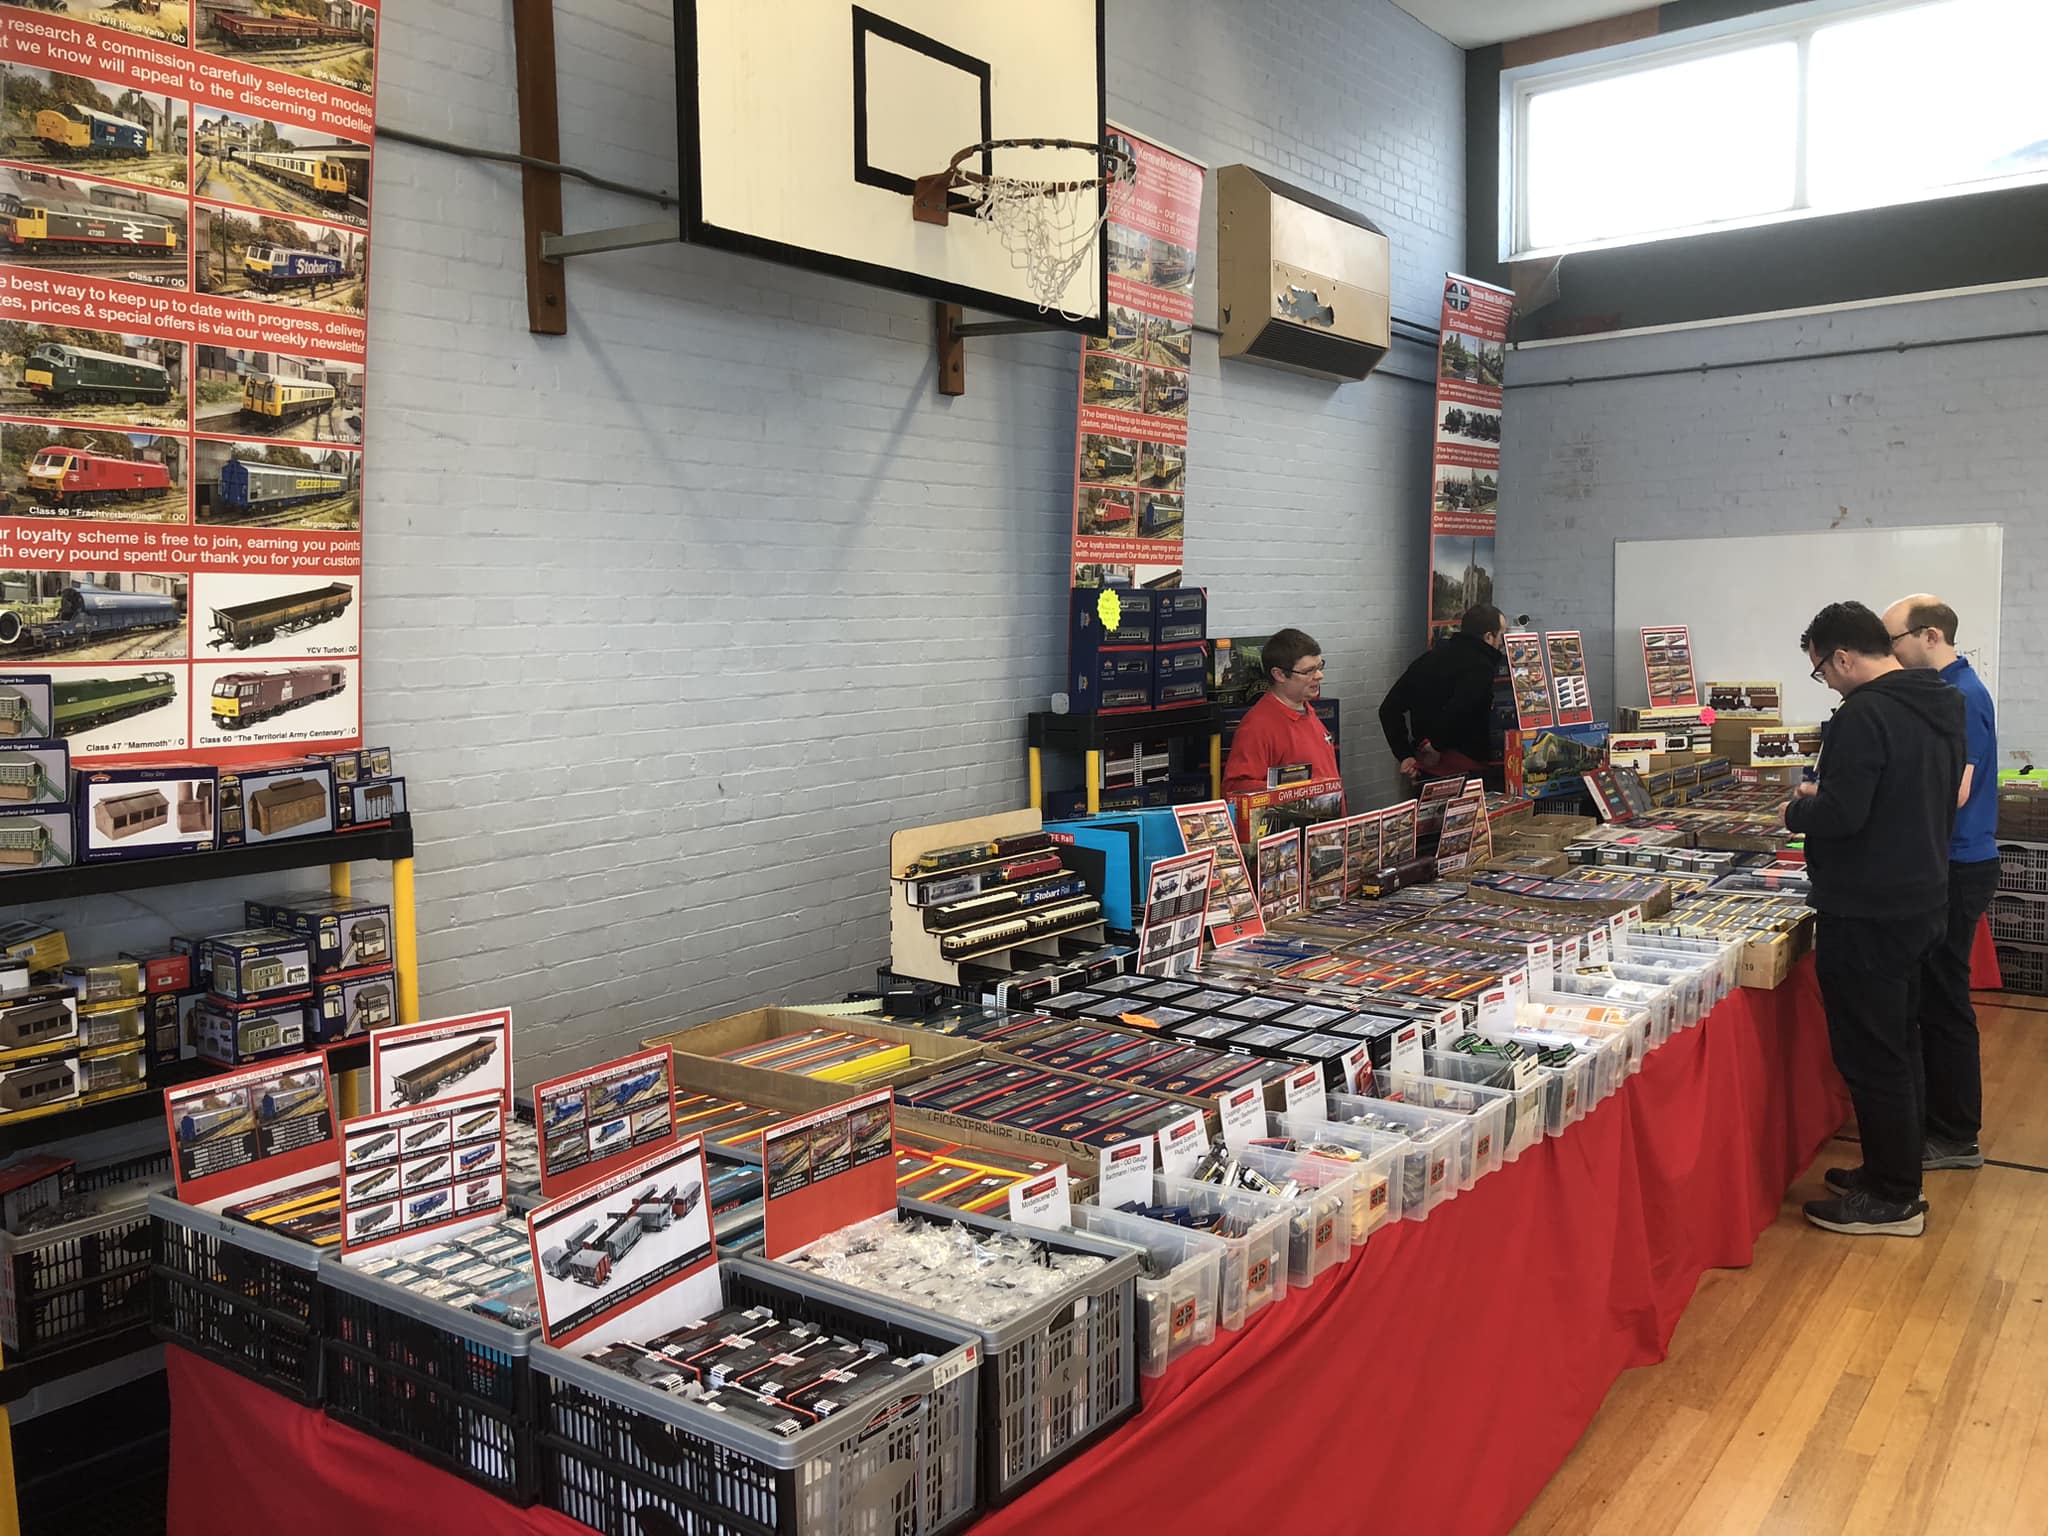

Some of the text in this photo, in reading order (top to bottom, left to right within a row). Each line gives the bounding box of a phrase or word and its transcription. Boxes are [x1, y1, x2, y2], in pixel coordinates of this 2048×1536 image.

[119, 20, 142, 33] Road
[143, 26, 166, 40] Vans
[8, 18, 82, 45] research
[86, 32, 98, 49] &
[102, 39, 196, 73] commission
[199, 63, 263, 91] carefully
[266, 80, 328, 105] selected
[331, 97, 373, 119] models
[16, 38, 42, 54] we
[47, 43, 92, 66] know
[99, 56, 126, 74] will
[130, 64, 184, 88] appeal
[188, 78, 205, 93] to
[211, 82, 235, 100] the
[239, 91, 317, 122] discerning
[321, 111, 373, 135] modeller
[312, 69, 329, 81] SPA
[330, 73, 358, 89] Wagons
[128, 171, 153, 183] Class
[322, 209, 342, 221] Class
[295, 257, 329, 276] Stobart
[128, 271, 153, 284] Class
[153, 276, 165, 285] 47
[11, 275, 50, 294] best
[53, 284, 86, 300] way
[90, 287, 106, 301] to
[108, 289, 147, 309] keep
[150, 297, 169, 313] up
[172, 299, 187, 313] to
[190, 302, 223, 319] date
[225, 308, 256, 323] with
[257, 313, 323, 335] progress,
[325, 322, 366, 342] delivery
[31, 299, 366, 354] prices & special offers is via our weekly newsletter
[318, 432, 338, 442] Class
[29, 506, 56, 516] Class
[57, 507, 70, 517] 90
[300, 519, 348, 531] Cargowaggon
[16, 527, 361, 553] loyalty scheme is free to join, earning you points
[18, 548, 361, 569] every pound spent! Our thank you for your custom
[306, 646, 322, 655] YCV
[323, 645, 344, 654] Turbot
[199, 736, 221, 745] Class
[222, 735, 233, 743] 60
[234, 733, 253, 742] "The
[253, 732, 288, 742] Territorial
[288, 730, 308, 741] Army
[309, 727, 348, 738] Centenary"
[86, 743, 110, 753] Class
[112, 742, 122, 751] 47
[124, 739, 173, 749] "Mammoth"
[1278, 780, 1342, 801] GWR HIGH SPEED TRAIN
[1060, 834, 1074, 844] Rail
[1034, 888, 1060, 902] Stobart
[926, 1111, 1013, 1138] LEICESTERSHIRE
[550, 1147, 684, 1214] KERNOW MODEL RAIL CENTRE EXCLUSIVES
